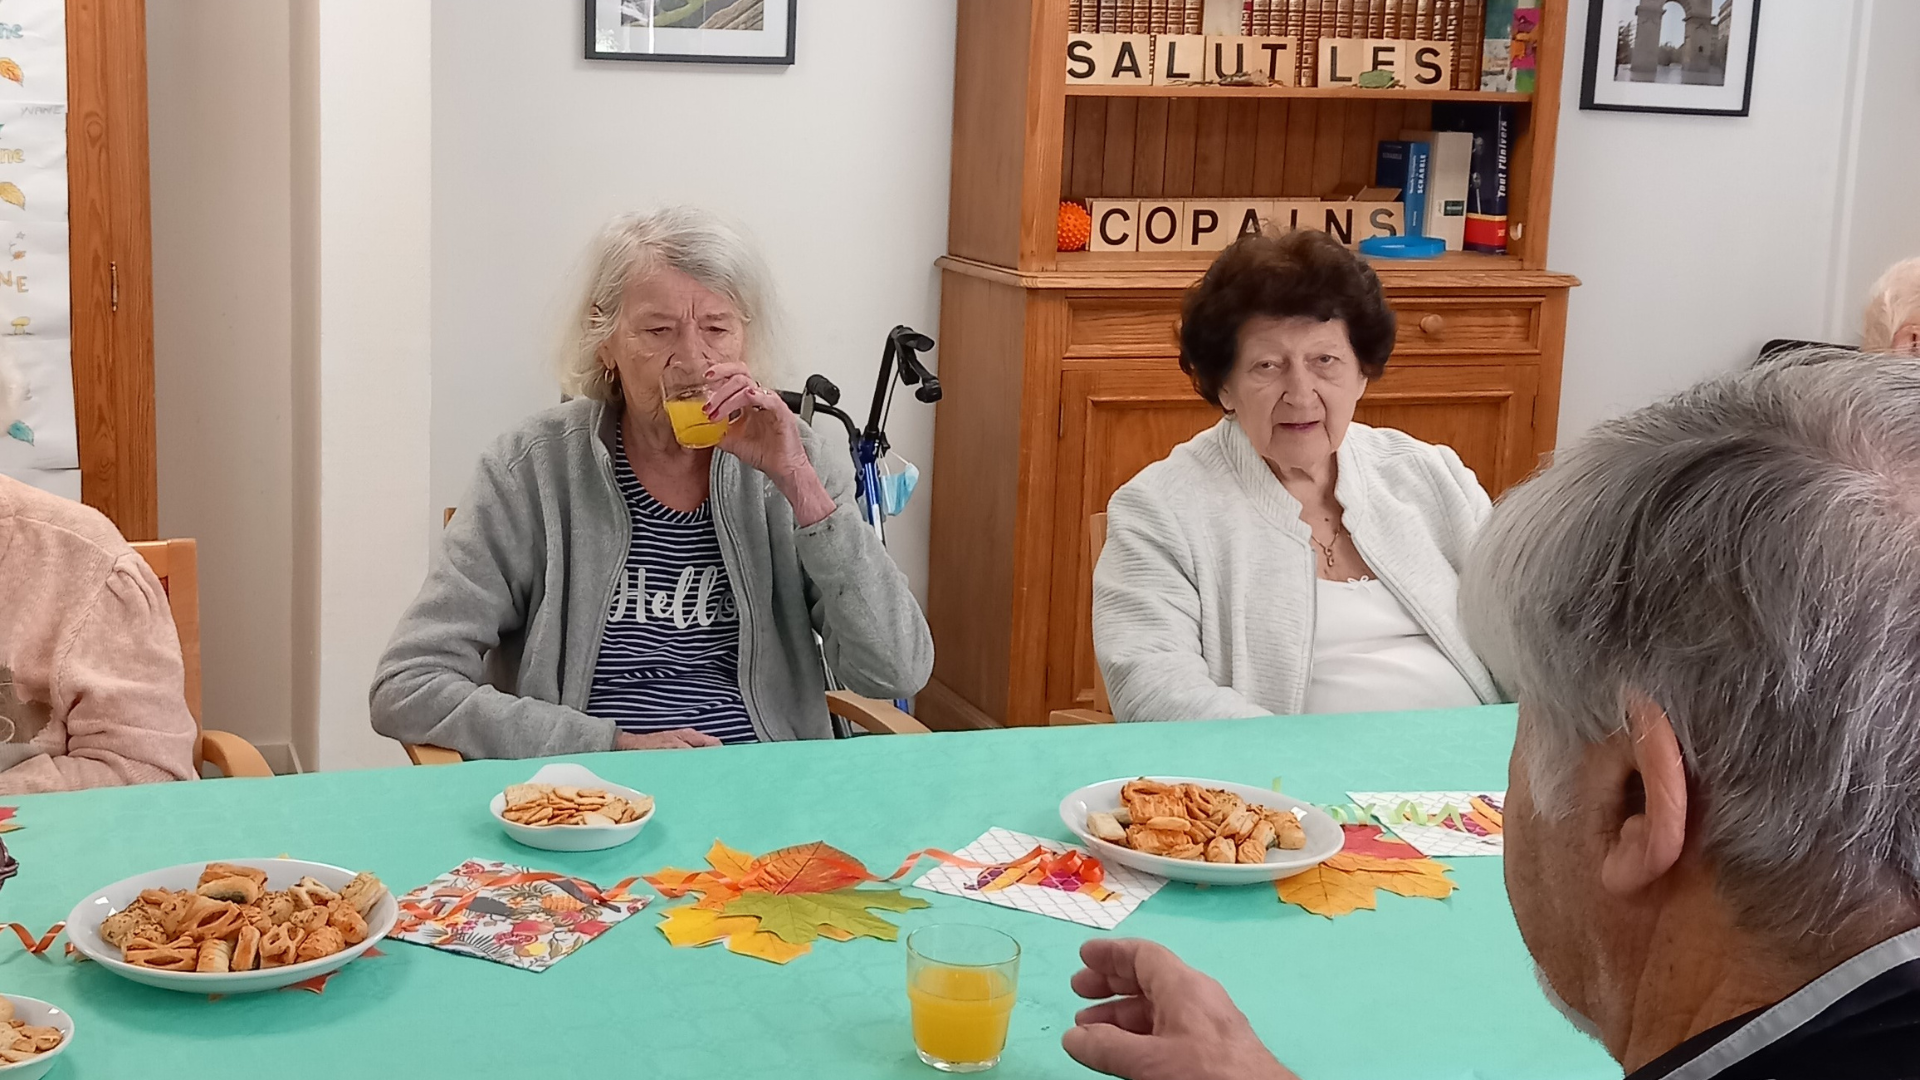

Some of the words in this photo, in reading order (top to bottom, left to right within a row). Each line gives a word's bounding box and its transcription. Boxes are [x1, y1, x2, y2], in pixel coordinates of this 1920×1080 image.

[1066, 40, 1288, 80] SALUT
[1329, 45, 1443, 84] LES
[1417, 154, 1427, 194] SCRABBLE
[1497, 173, 1507, 197] Tout
[1099, 206, 1397, 246] COPAINS
[607, 565, 739, 629] Hello
